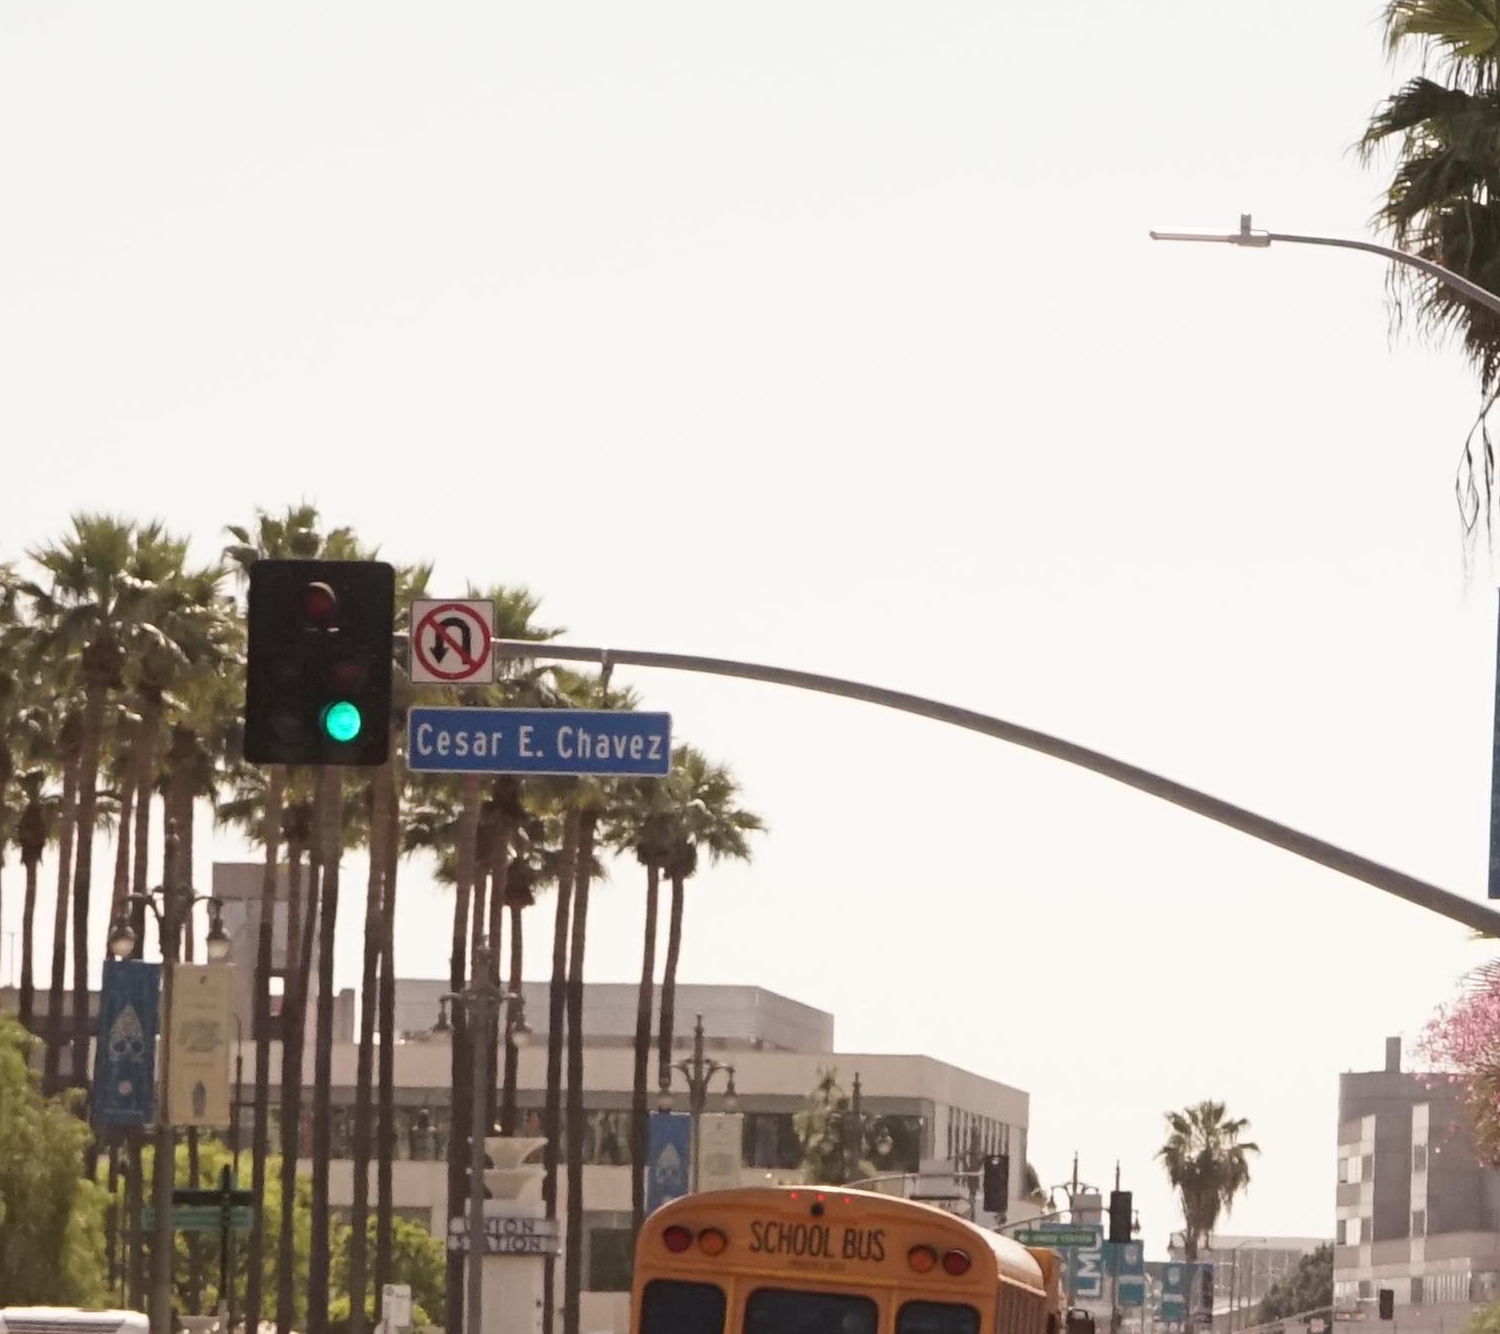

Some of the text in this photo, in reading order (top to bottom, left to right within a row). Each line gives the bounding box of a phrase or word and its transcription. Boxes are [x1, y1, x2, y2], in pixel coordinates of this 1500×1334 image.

[416, 723, 663, 761] Cesar E. Chavez
[748, 1220, 886, 1262] SCHOOL BUS
